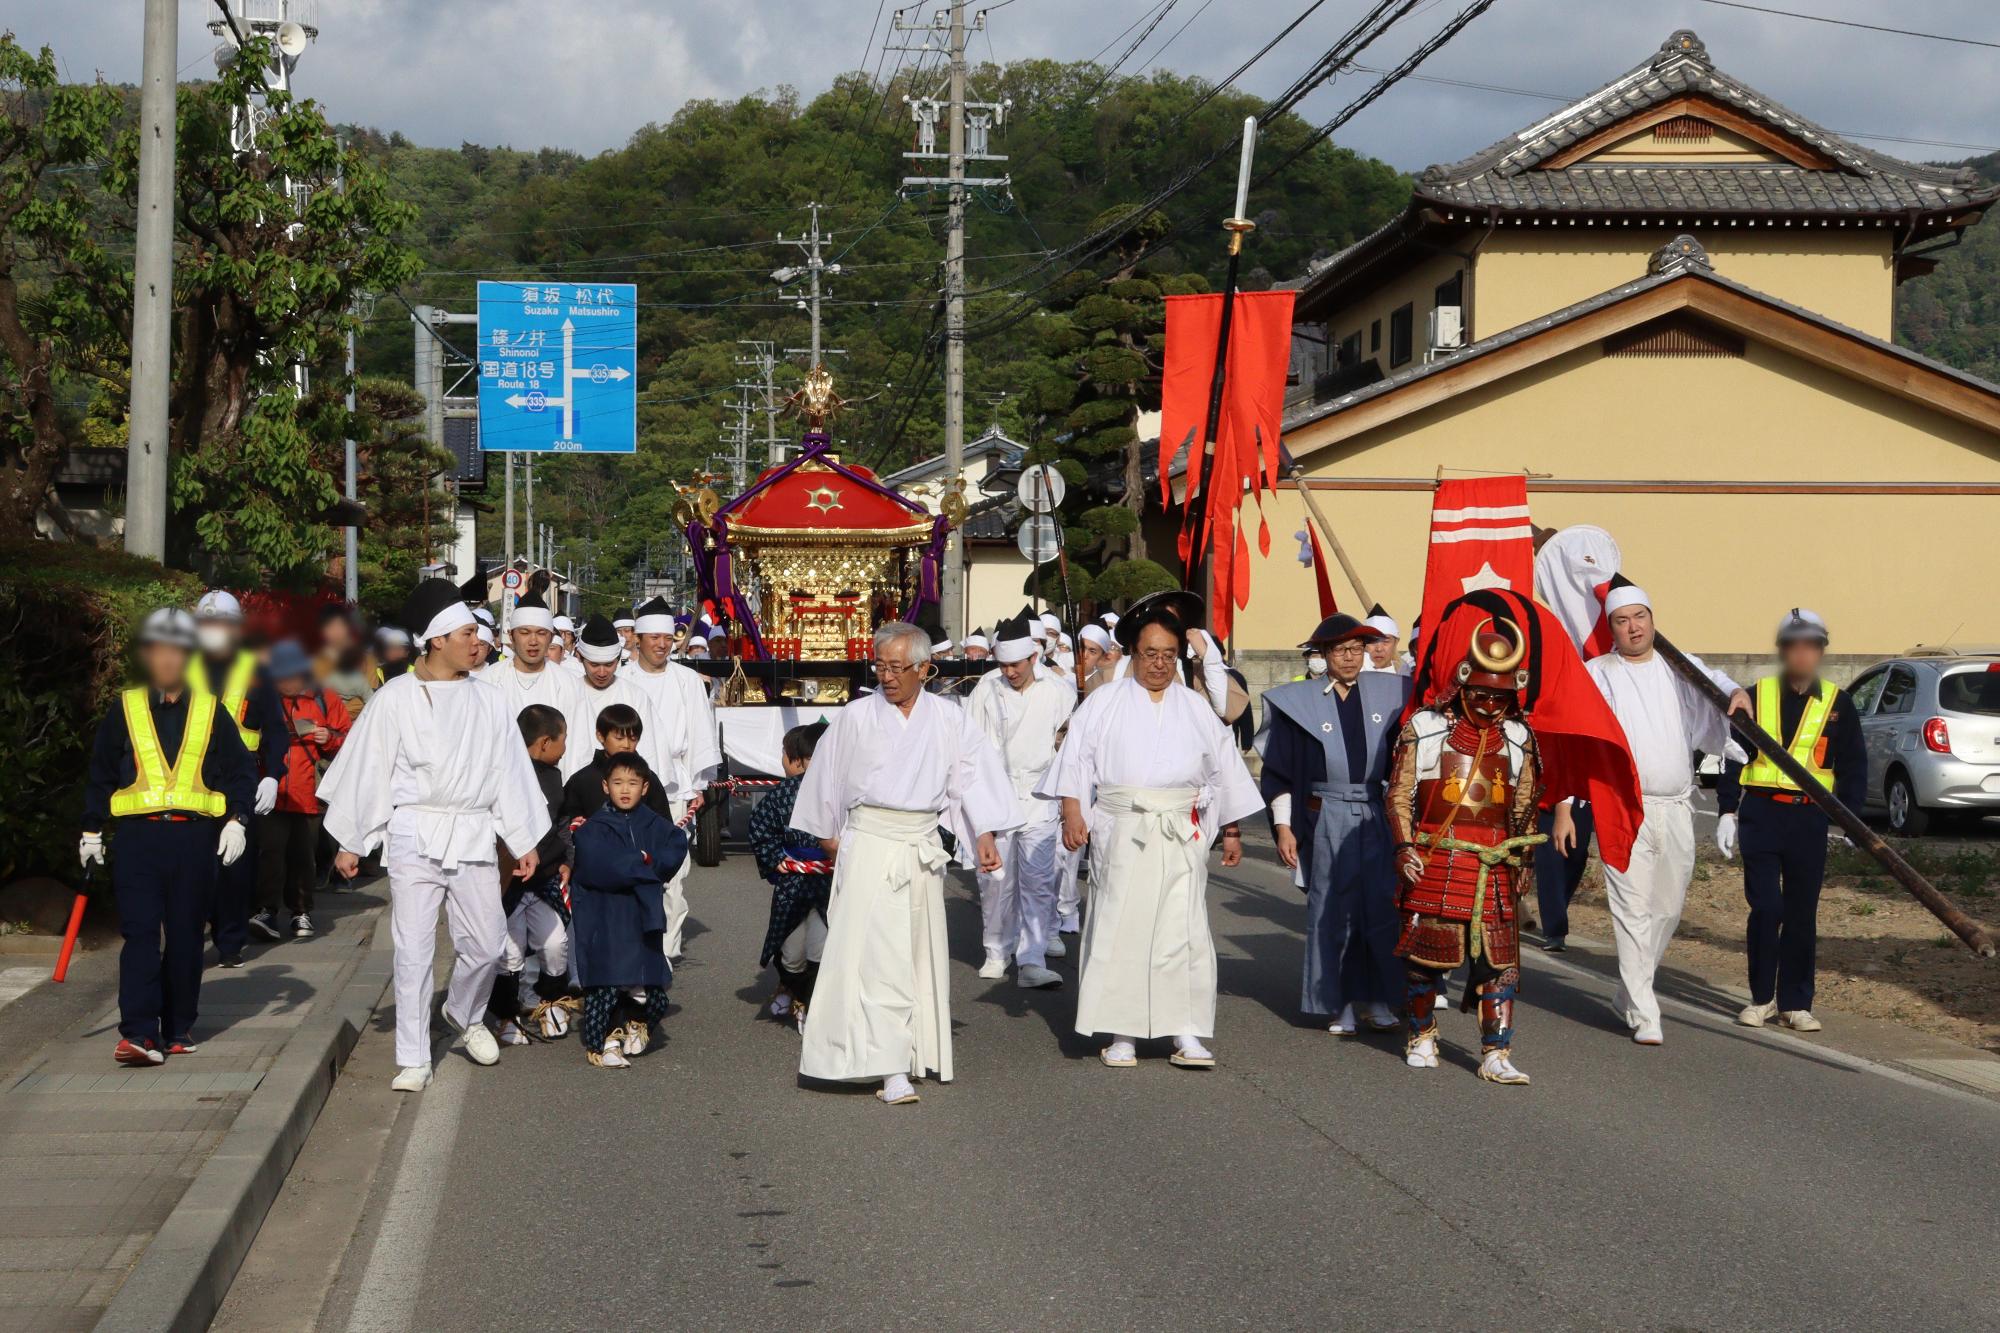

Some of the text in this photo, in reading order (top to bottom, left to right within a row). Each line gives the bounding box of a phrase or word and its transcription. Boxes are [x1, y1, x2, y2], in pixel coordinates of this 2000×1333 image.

[522, 287, 615, 305] 須坂 松代
[524, 306, 620, 316] Suzaka Matsushiro
[492, 329, 546, 346] 篠ノ井
[499, 348, 539, 357] Shinonoi
[483, 361, 555, 378] 国道18号
[591, 369, 609, 378] 335
[498, 380, 540, 389] Route 18
[528, 396, 544, 406] 335
[553, 441, 583, 450] 200m
[507, 575, 518, 585] 40
